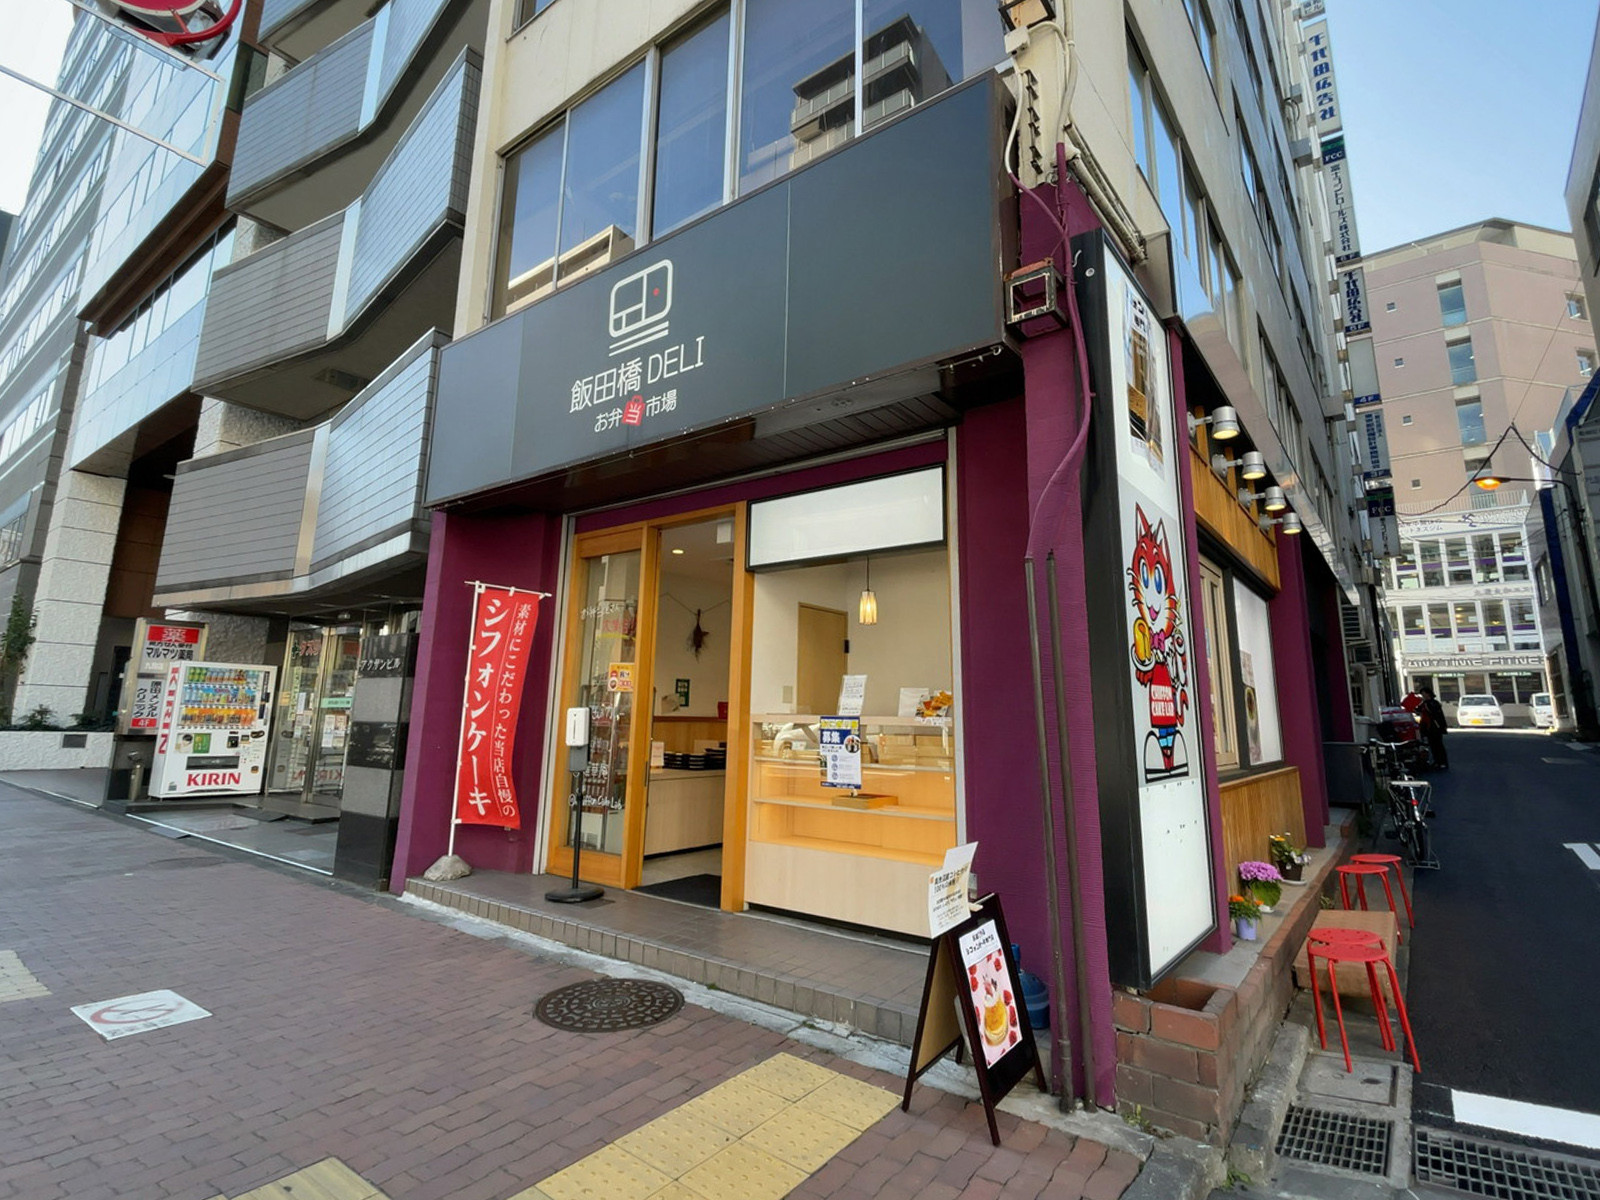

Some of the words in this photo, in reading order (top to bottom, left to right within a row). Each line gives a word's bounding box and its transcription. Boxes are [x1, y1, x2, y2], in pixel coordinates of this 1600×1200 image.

[1324, 150, 1343, 162] FCC
[569, 357, 643, 413] 飯田橋
[647, 336, 705, 384] DELI
[594, 389, 677, 432] お弁当市場
[1372, 505, 1392, 515] FCC
[162, 627, 187, 643] 薬
[145, 647, 194, 660] マルマツ薬局
[1407, 656, 1484, 669] ANYTIME
[133, 688, 148, 718] クリニック
[468, 598, 510, 816] シフォンケーキ
[492, 602, 532, 818] 素材にこだわった当店自慢の
[138, 718, 150, 726] 4F
[821, 730, 841, 744] 募集
[187, 772, 241, 787] KIRIN
